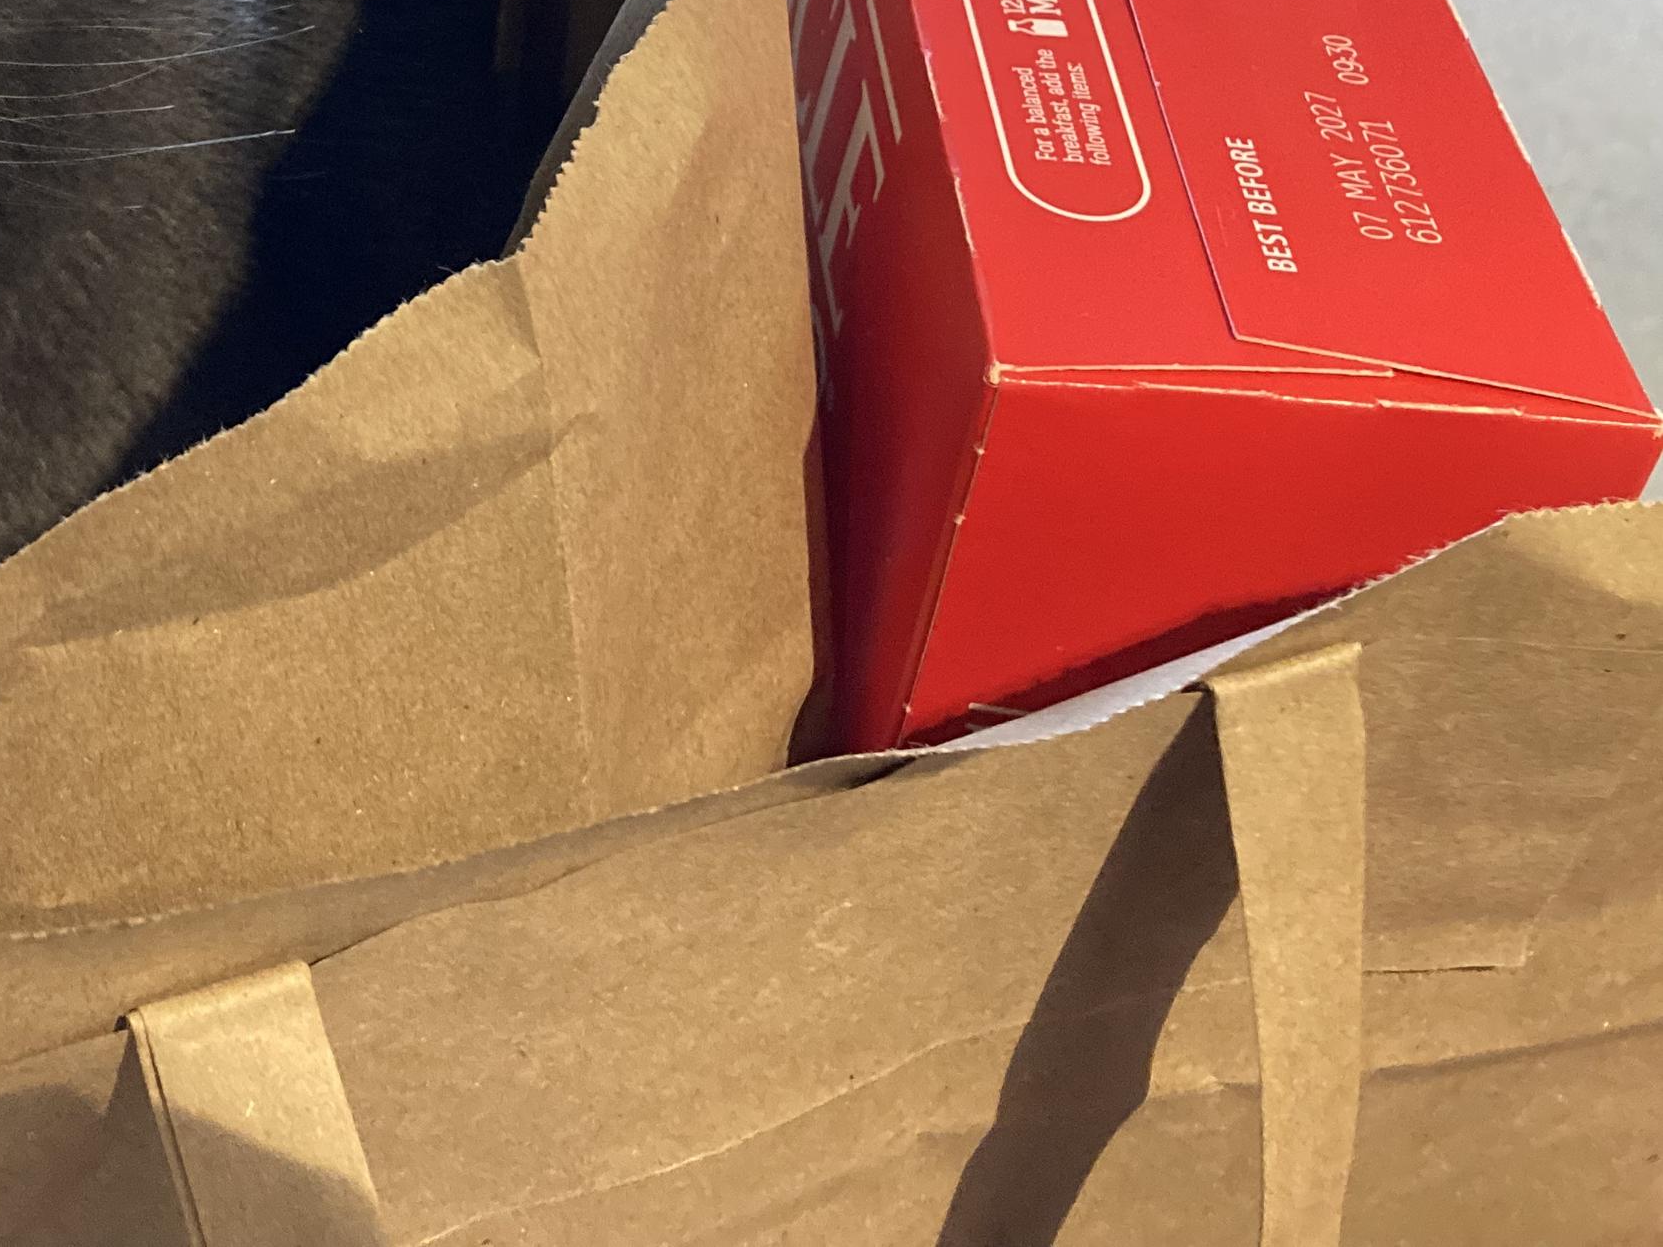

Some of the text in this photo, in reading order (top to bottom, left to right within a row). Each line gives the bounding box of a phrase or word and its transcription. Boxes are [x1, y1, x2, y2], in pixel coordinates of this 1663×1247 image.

[1012, 66, 1057, 162] For a balanced
[1036, 48, 1084, 163] breakfast, add the
[1079, 103, 1112, 166] following
[1304, 91, 1354, 142] 2027
[1225, 136, 1298, 273] BEST BEFORE
[1329, 152, 1377, 201] MAY
[1358, 120, 1443, 244] 612736071
[1352, 210, 1394, 240] 07
